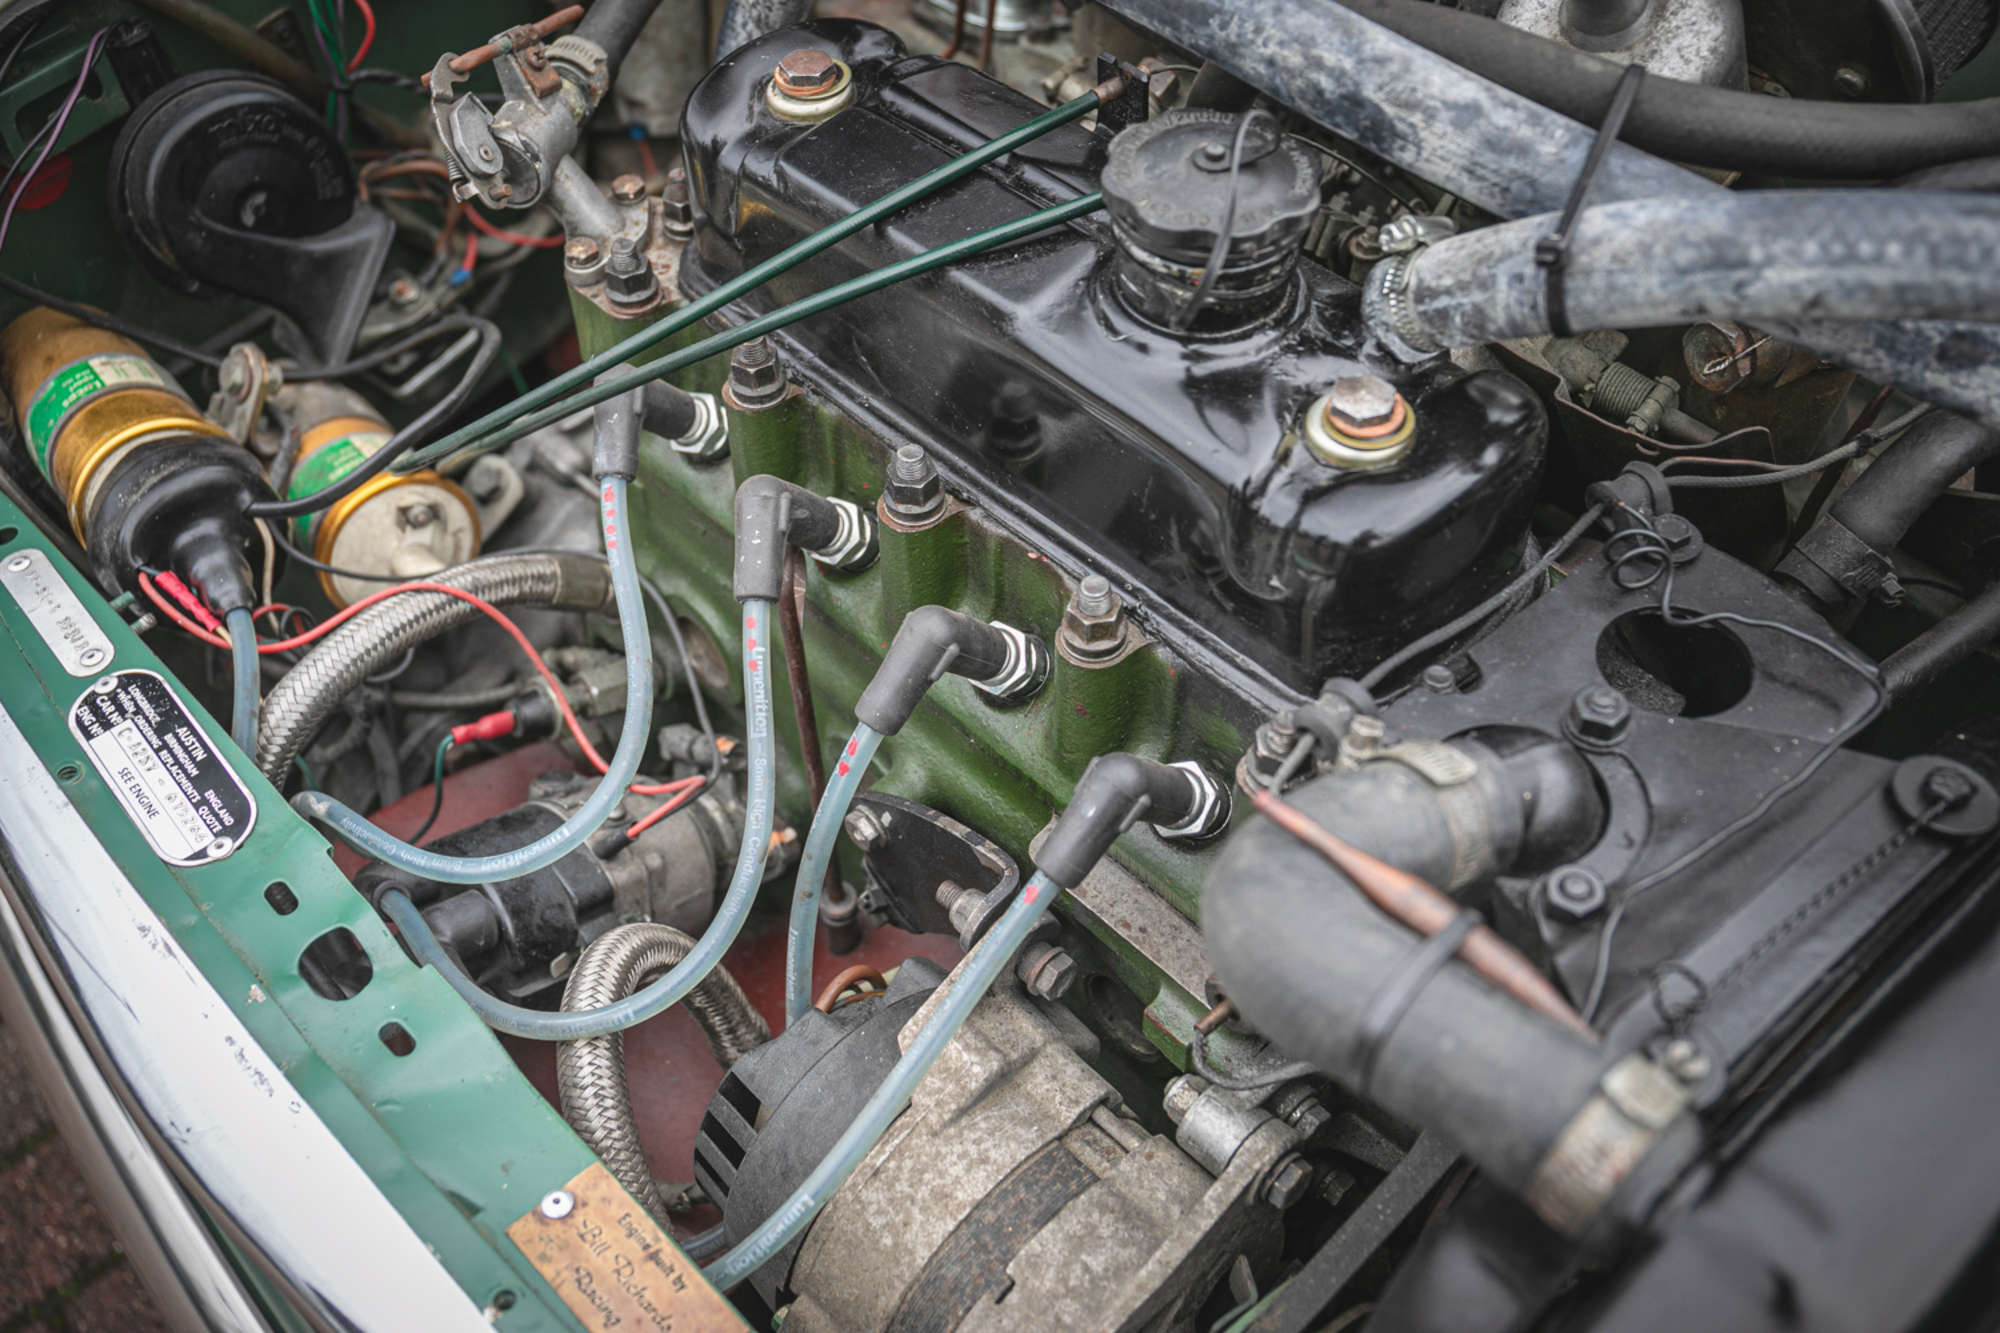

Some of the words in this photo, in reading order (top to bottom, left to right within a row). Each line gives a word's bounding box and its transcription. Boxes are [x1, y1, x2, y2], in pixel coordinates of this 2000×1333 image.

[96, 695, 116, 716] CAR
[176, 727, 207, 762] AUSTIN
[77, 706, 97, 727] ENG
[118, 767, 135, 784] SEE
[129, 784, 160, 820] ENGINE
[134, 715, 162, 749] ORDERING
[158, 749, 201, 803] REPLACEMENTS
[199, 806, 222, 834] QUOTE
[164, 733, 199, 777] BIRMINGHAM
[204, 789, 234, 826] ENGLAND
[577, 1219, 612, 1256] Bill
[617, 1212, 652, 1251] Engine
[671, 1273, 688, 1294] by
[726, 1192, 816, 1276] Lumenition
[575, 1266, 621, 1329] Racing
